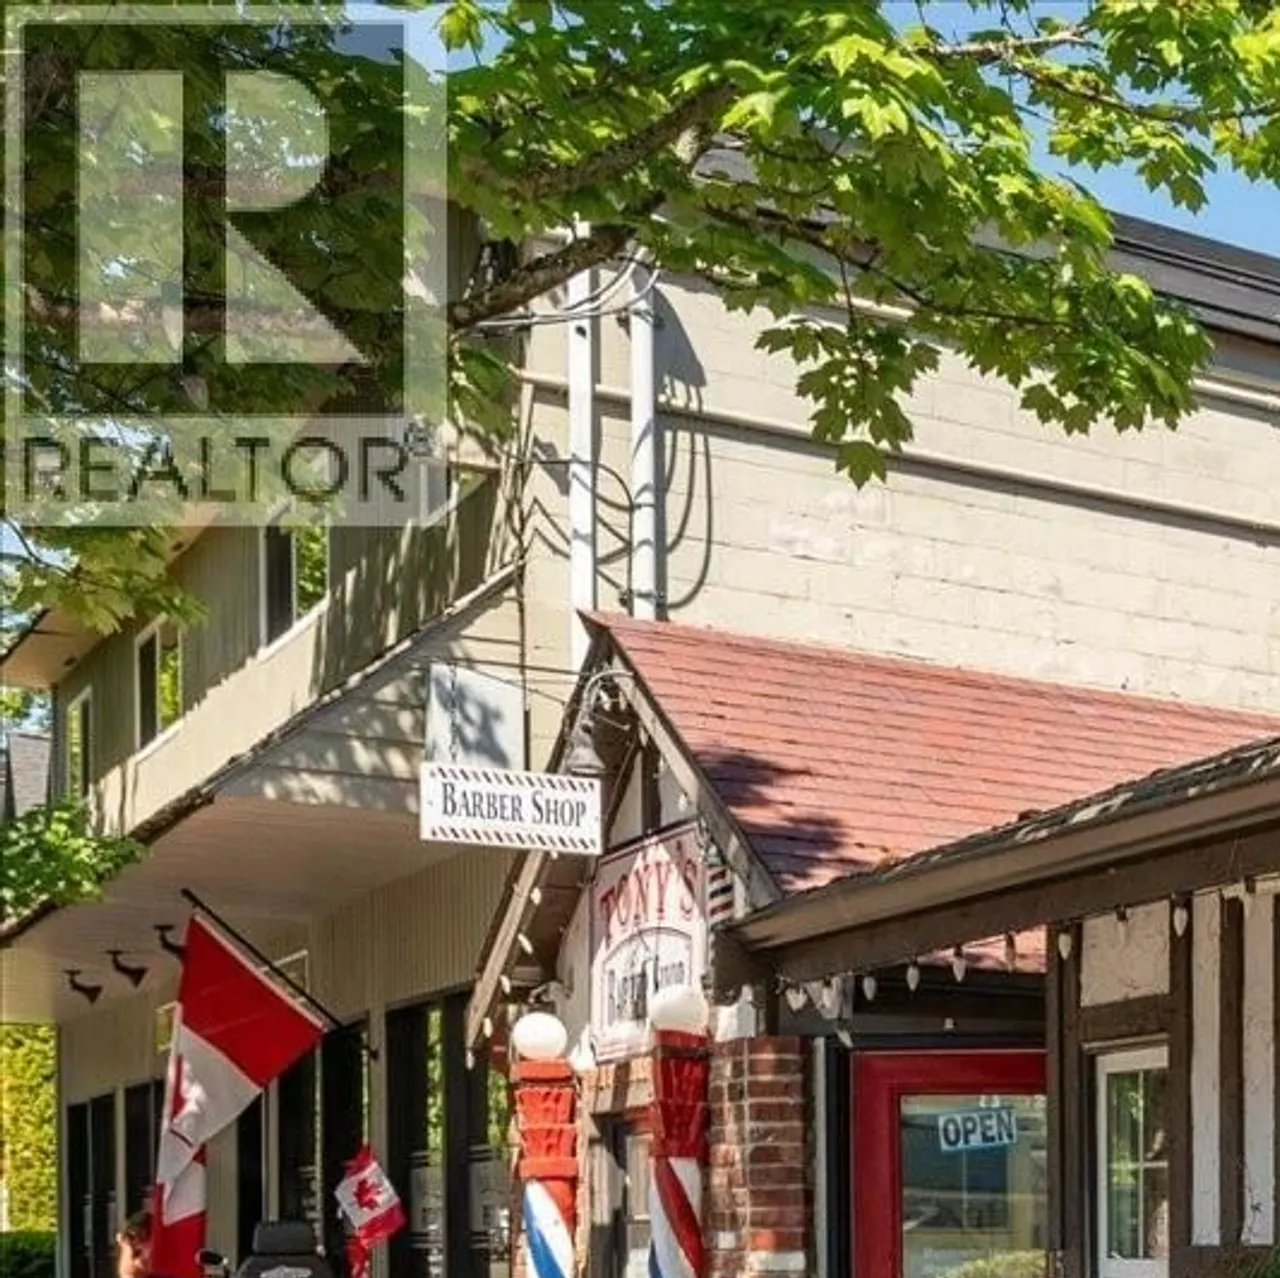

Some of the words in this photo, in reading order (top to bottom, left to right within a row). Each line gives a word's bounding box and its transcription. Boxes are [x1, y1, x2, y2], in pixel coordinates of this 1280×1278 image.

[441, 781, 525, 822] BARBER
[531, 789, 587, 827] SHOP
[597, 838, 699, 951] TONY'S
[942, 1110, 1015, 1147] OPEN
